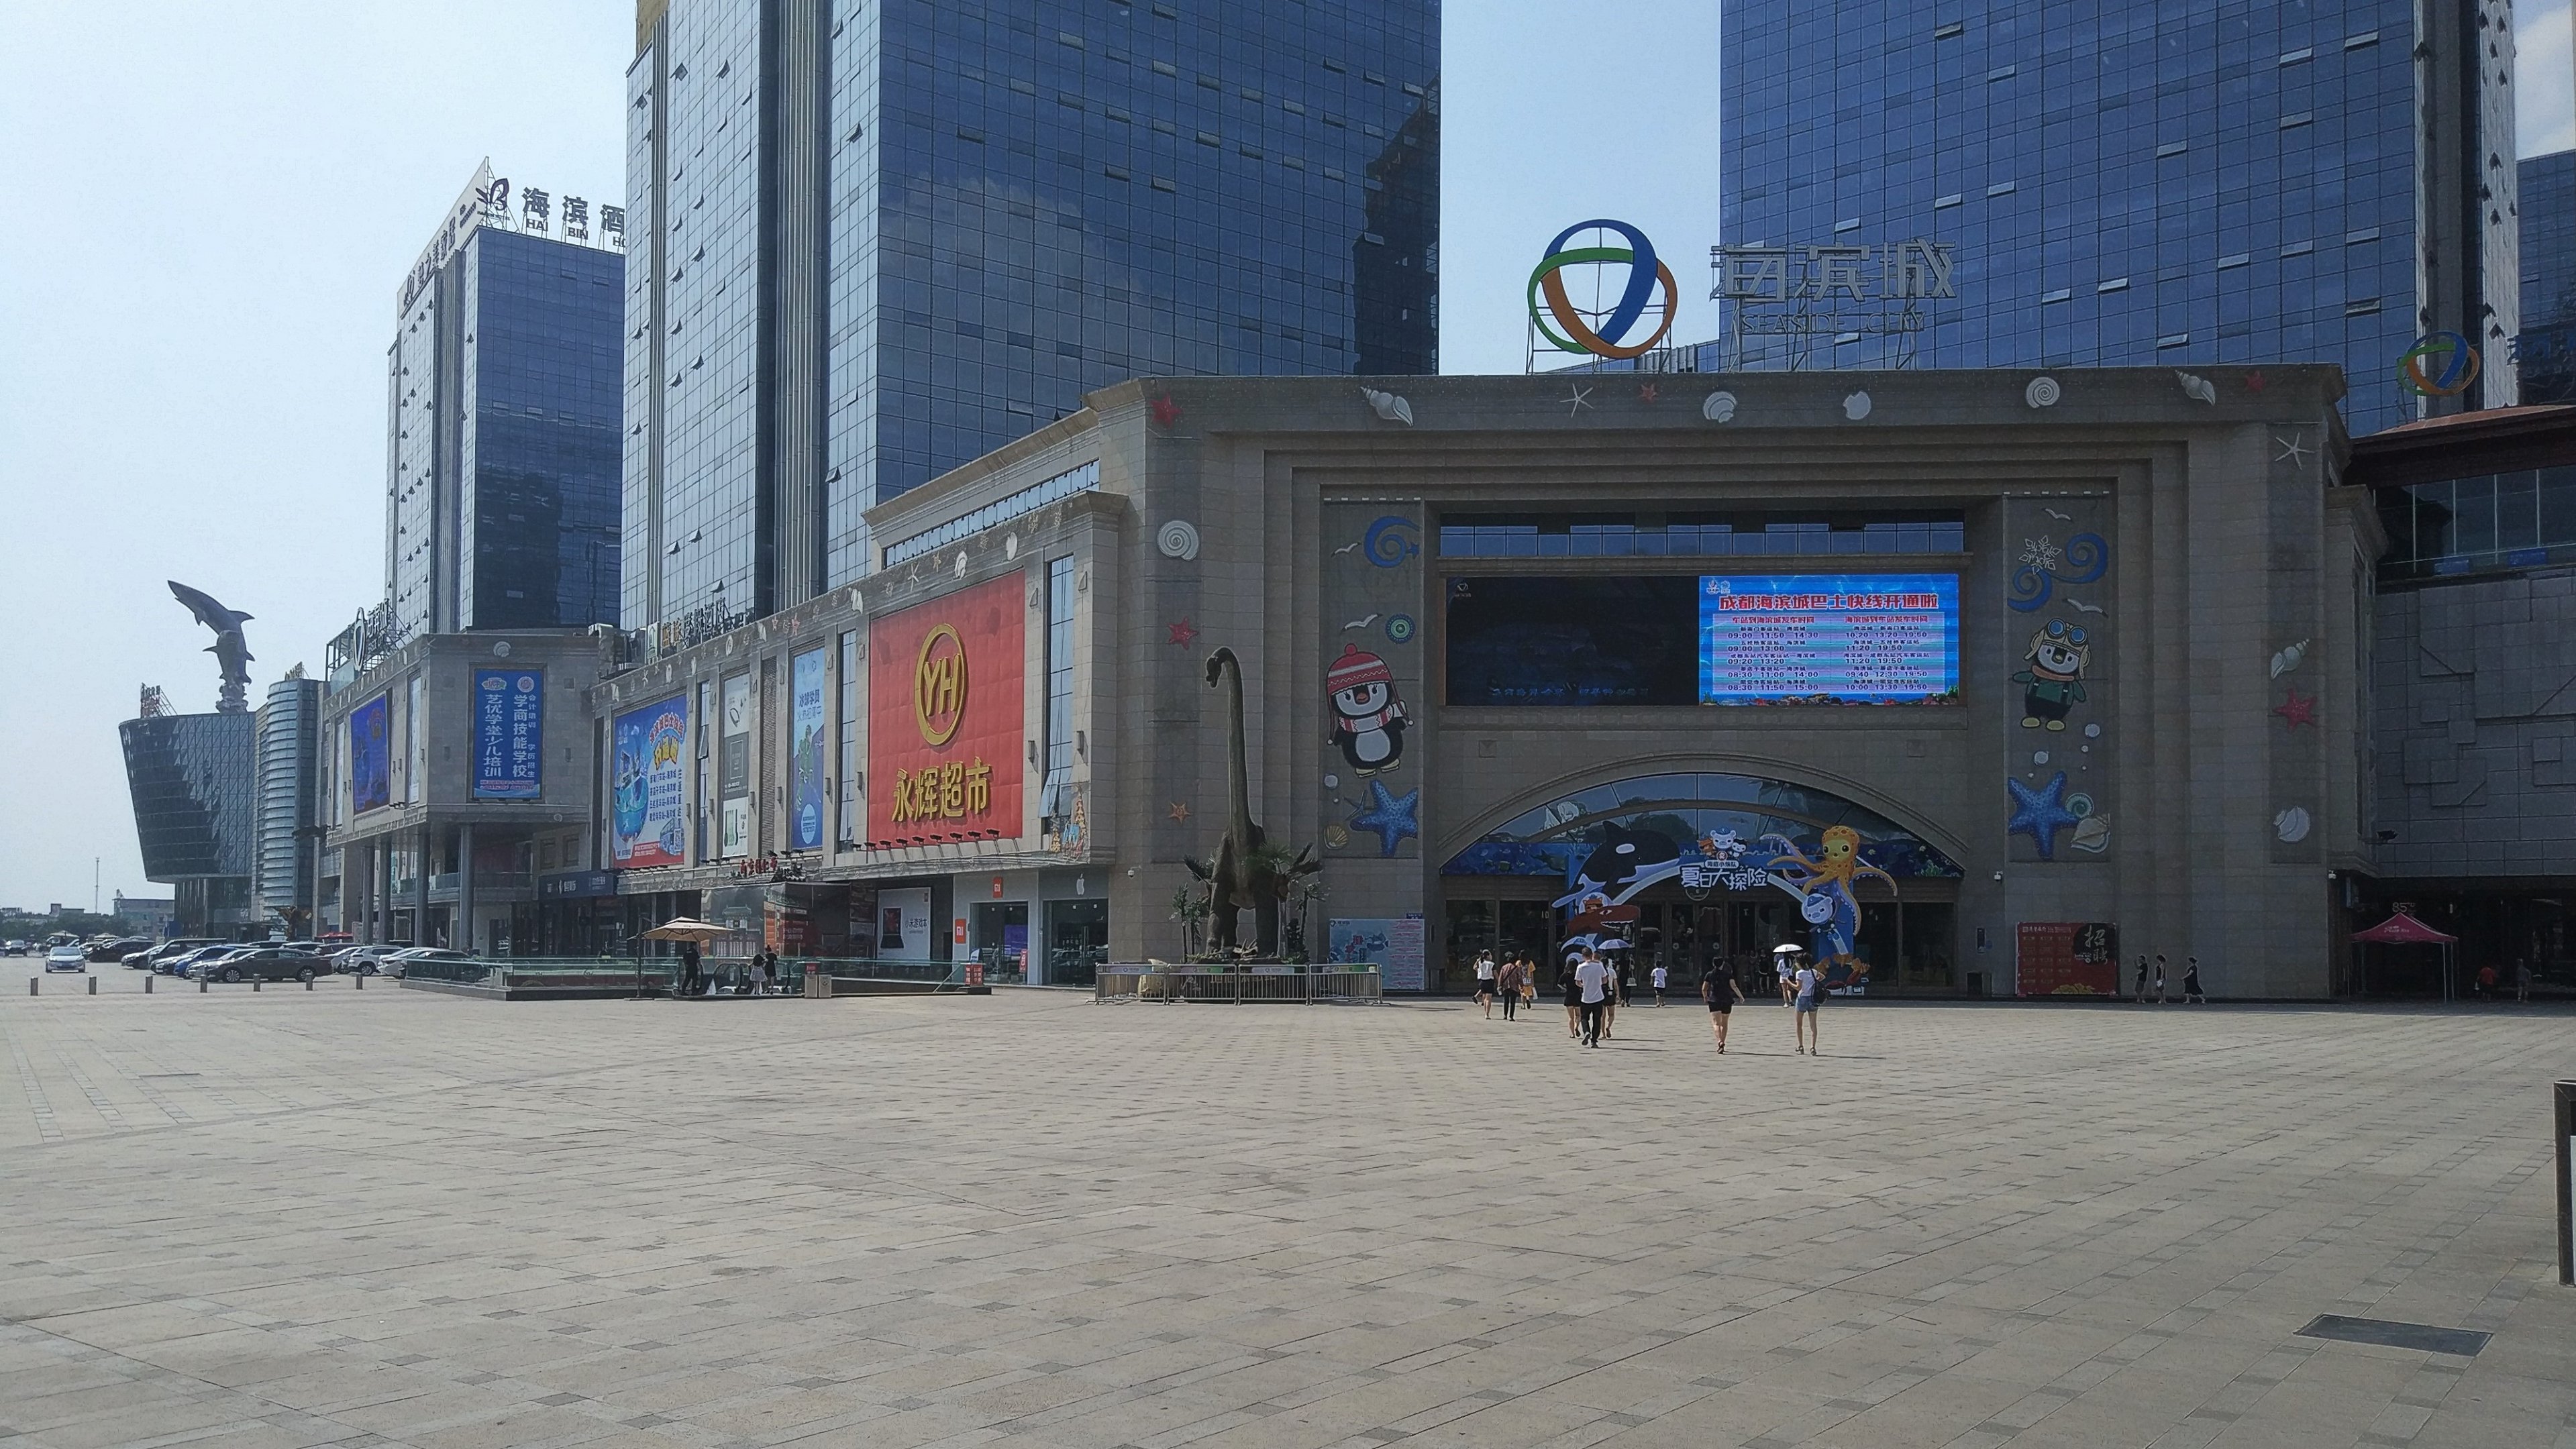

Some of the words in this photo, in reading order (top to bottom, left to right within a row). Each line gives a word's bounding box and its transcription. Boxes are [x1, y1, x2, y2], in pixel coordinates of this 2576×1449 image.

[527, 218, 548, 232] HAI
[568, 226, 588, 240] BIN
[1742, 313, 1847, 335] SEASIDE
[1867, 311, 1925, 331] CITY
[1718, 593, 1939, 610] 成都海滨城巴士快线开通啦
[923, 653, 961, 716] YH
[483, 694, 503, 777] 艺优学堂少儿培训
[512, 694, 527, 777] 学商技能学校
[891, 756, 992, 822] 永辉超市
[1681, 867, 1767, 891] 夏日大探险
